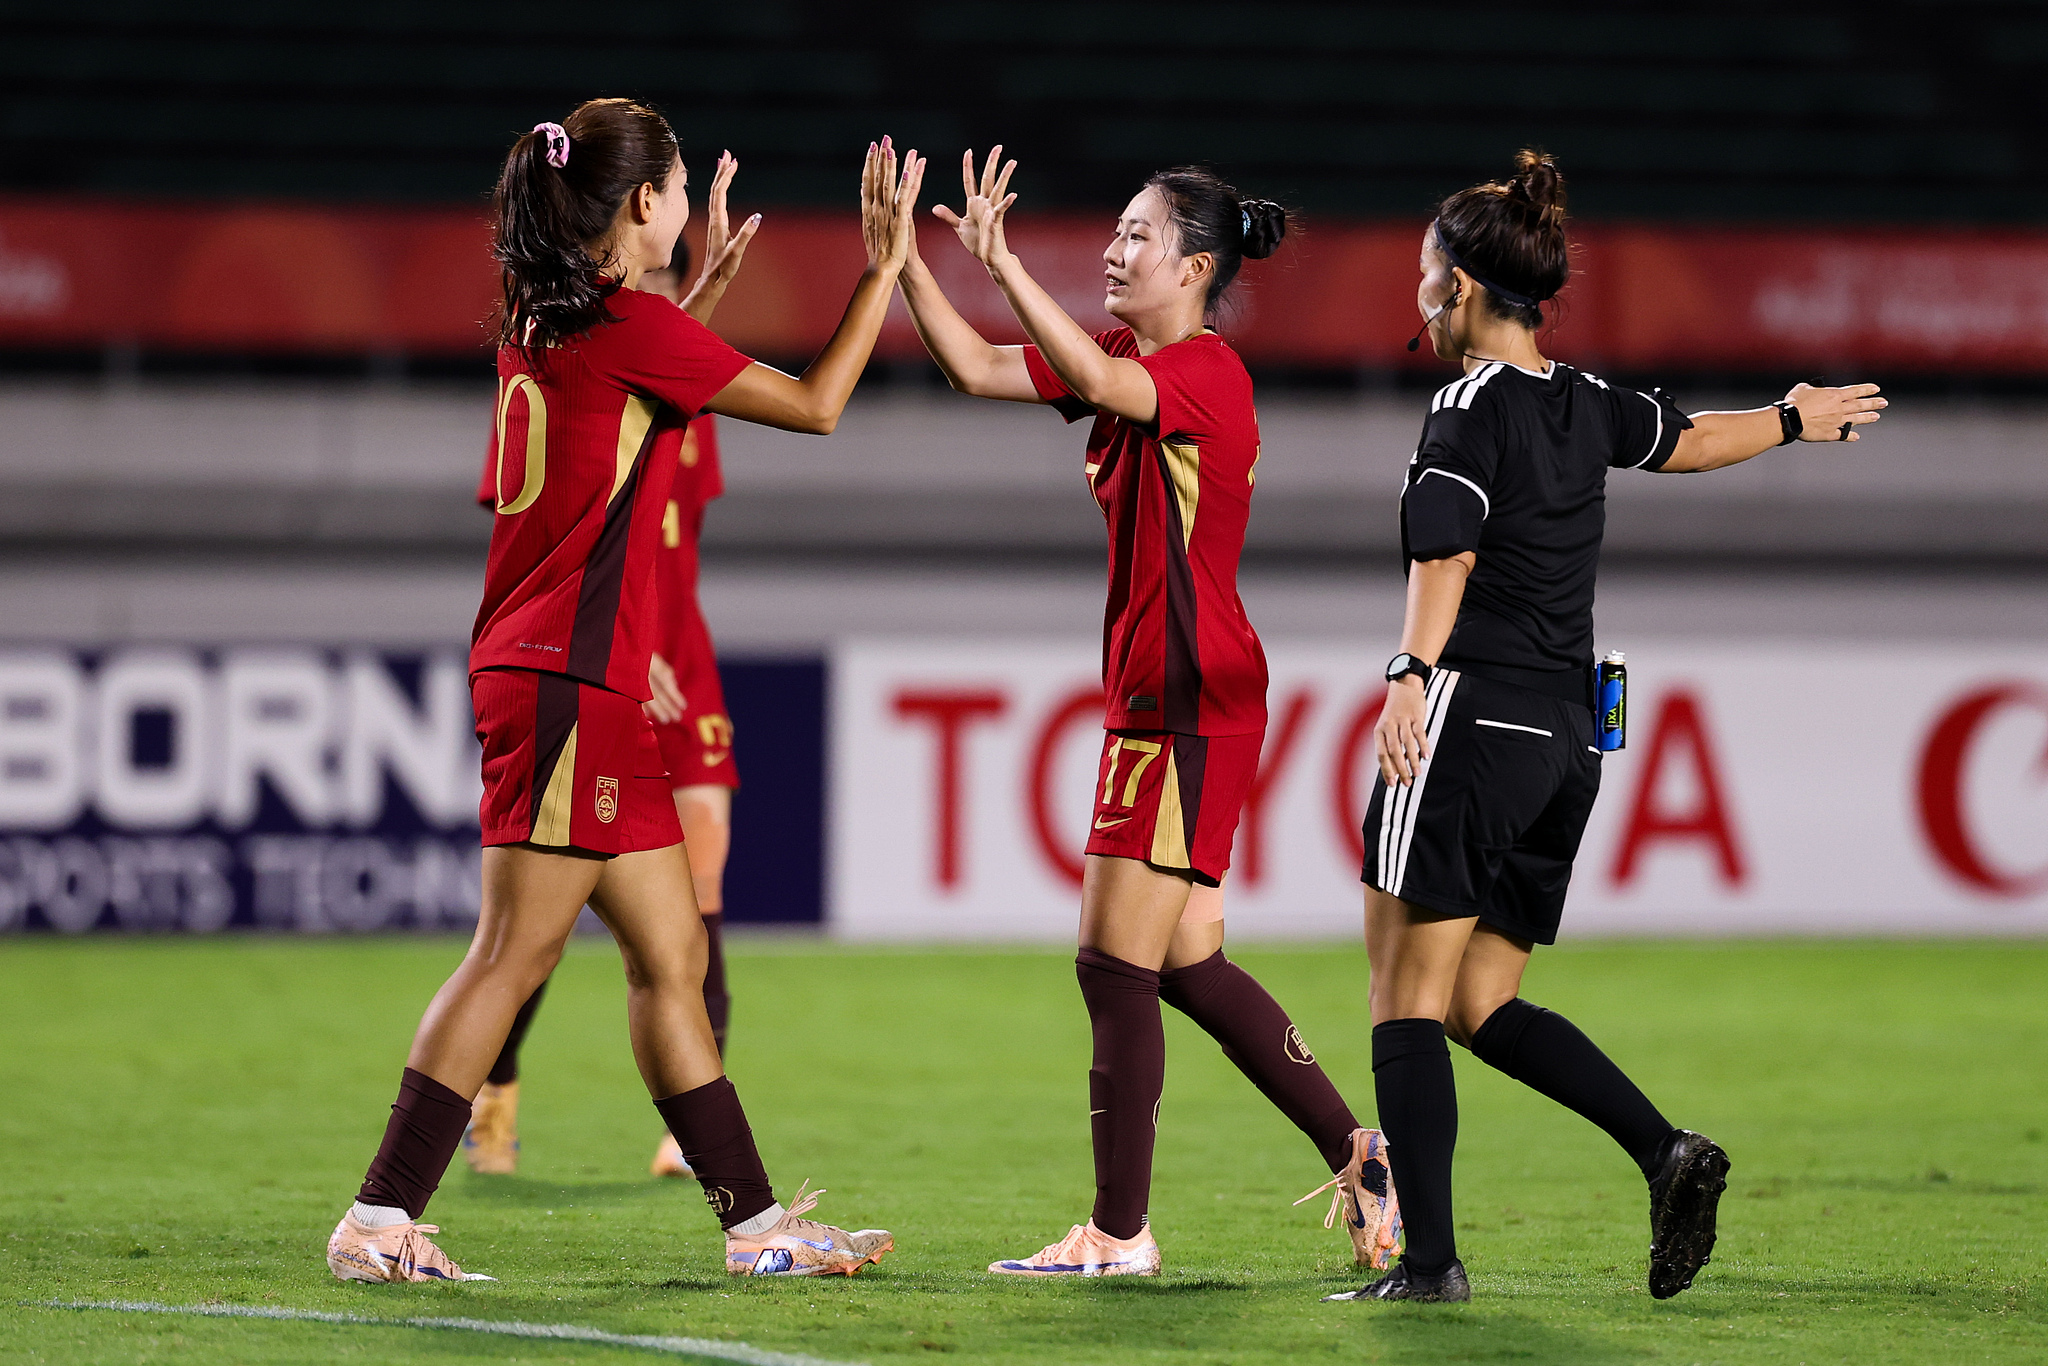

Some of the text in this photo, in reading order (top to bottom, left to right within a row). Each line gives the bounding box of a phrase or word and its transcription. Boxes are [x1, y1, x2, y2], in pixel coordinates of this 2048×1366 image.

[496, 373, 548, 515] 0
[0, 652, 484, 830] BORN
[598, 779, 617, 790] CFA
[1101, 737, 1162, 808] 17
